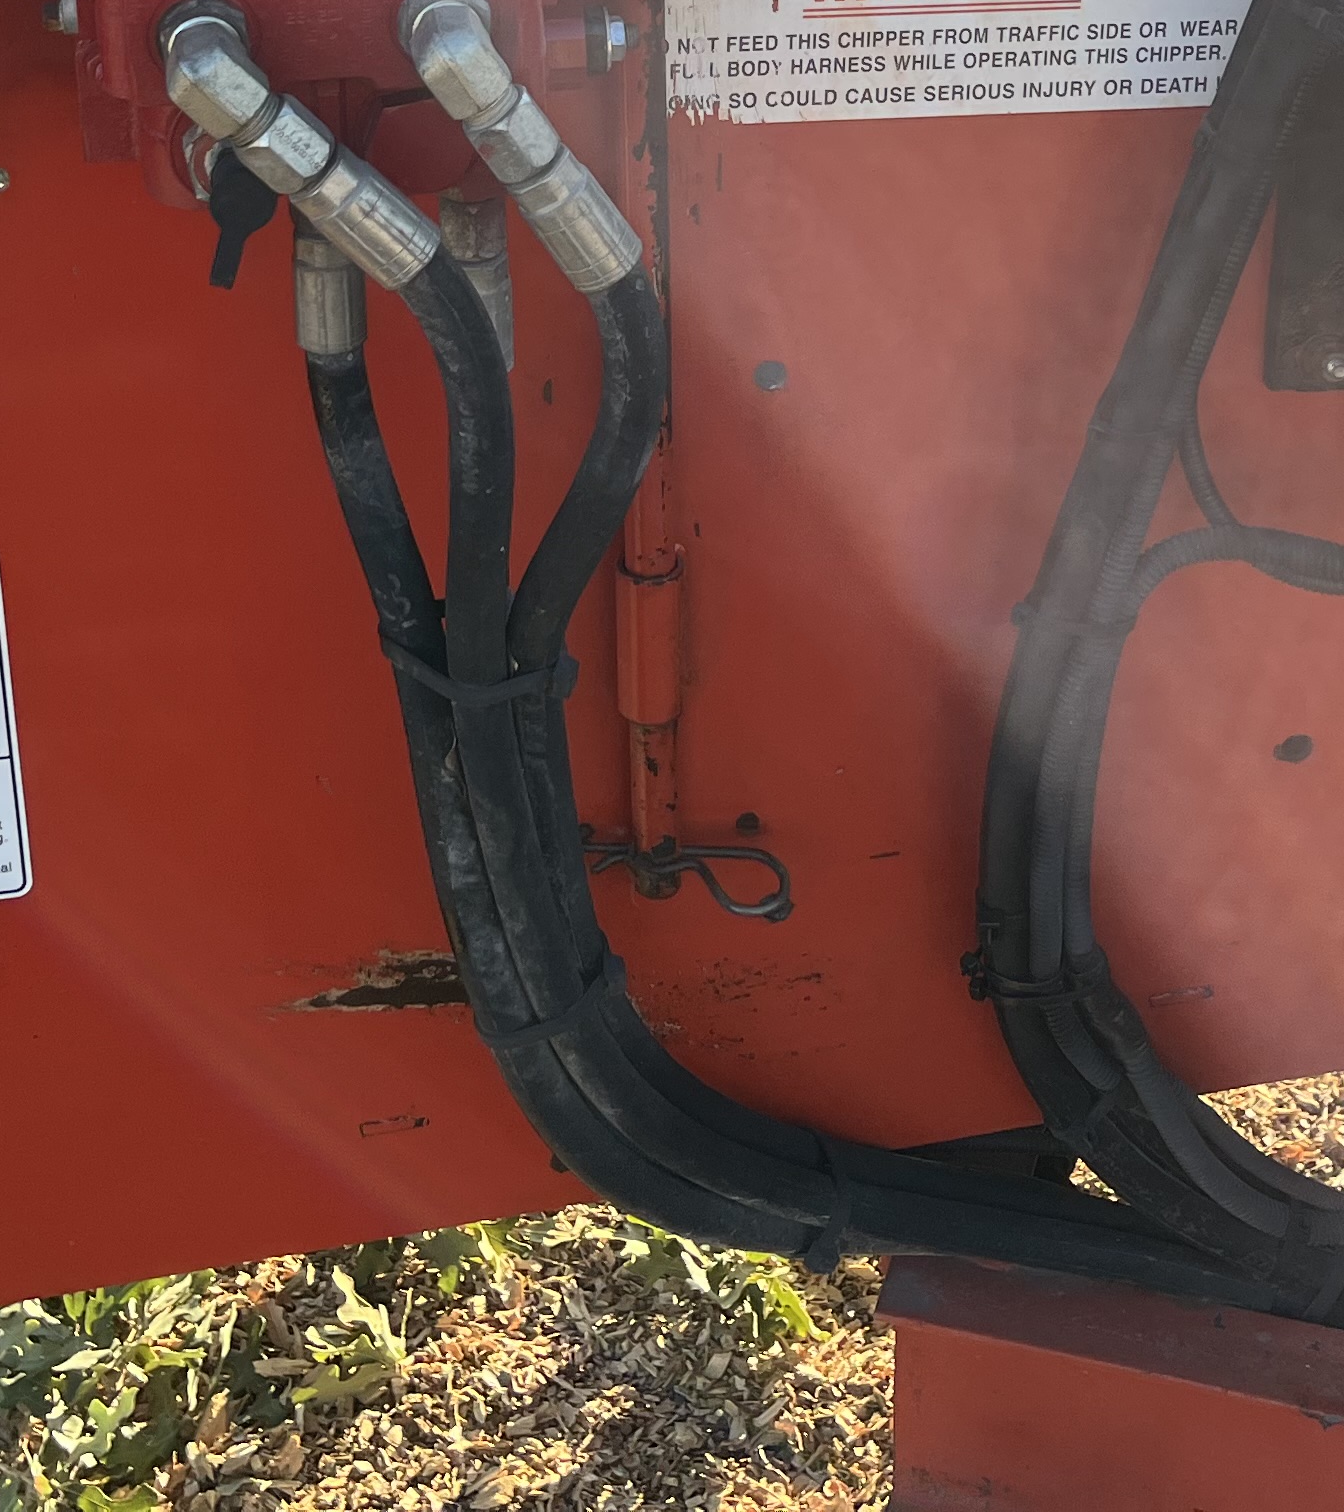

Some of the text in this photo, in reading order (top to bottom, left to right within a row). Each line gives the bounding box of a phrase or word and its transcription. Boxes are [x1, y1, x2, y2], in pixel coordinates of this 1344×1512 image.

[726, 35, 778, 53] FEED
[785, 32, 830, 50] THIS
[838, 29, 925, 49] CHIPPER
[932, 27, 989, 45] FROM
[996, 24, 1079, 43] TRAFFIC
[1086, 22, 1132, 40] SIDE
[1139, 21, 1167, 39] OR
[1180, 19, 1236, 37] WEAR
[727, 59, 782, 78] BODY
[791, 55, 886, 75] HARNESS
[893, 53, 956, 71] WHILE
[963, 49, 1077, 69] OPERATING
[1084, 47, 1128, 65] THIS
[1135, 44, 1230, 64] CHIPPER.
[728, 92, 757, 109] SO
[765, 89, 837, 108] COULD
[845, 86, 916, 105] CAUSE
[923, 82, 1015, 102] SERIOUS
[1022, 80, 1096, 98] INJURY
[1103, 79, 1133, 96] OR
[1140, 76, 1208, 95] DEATH
